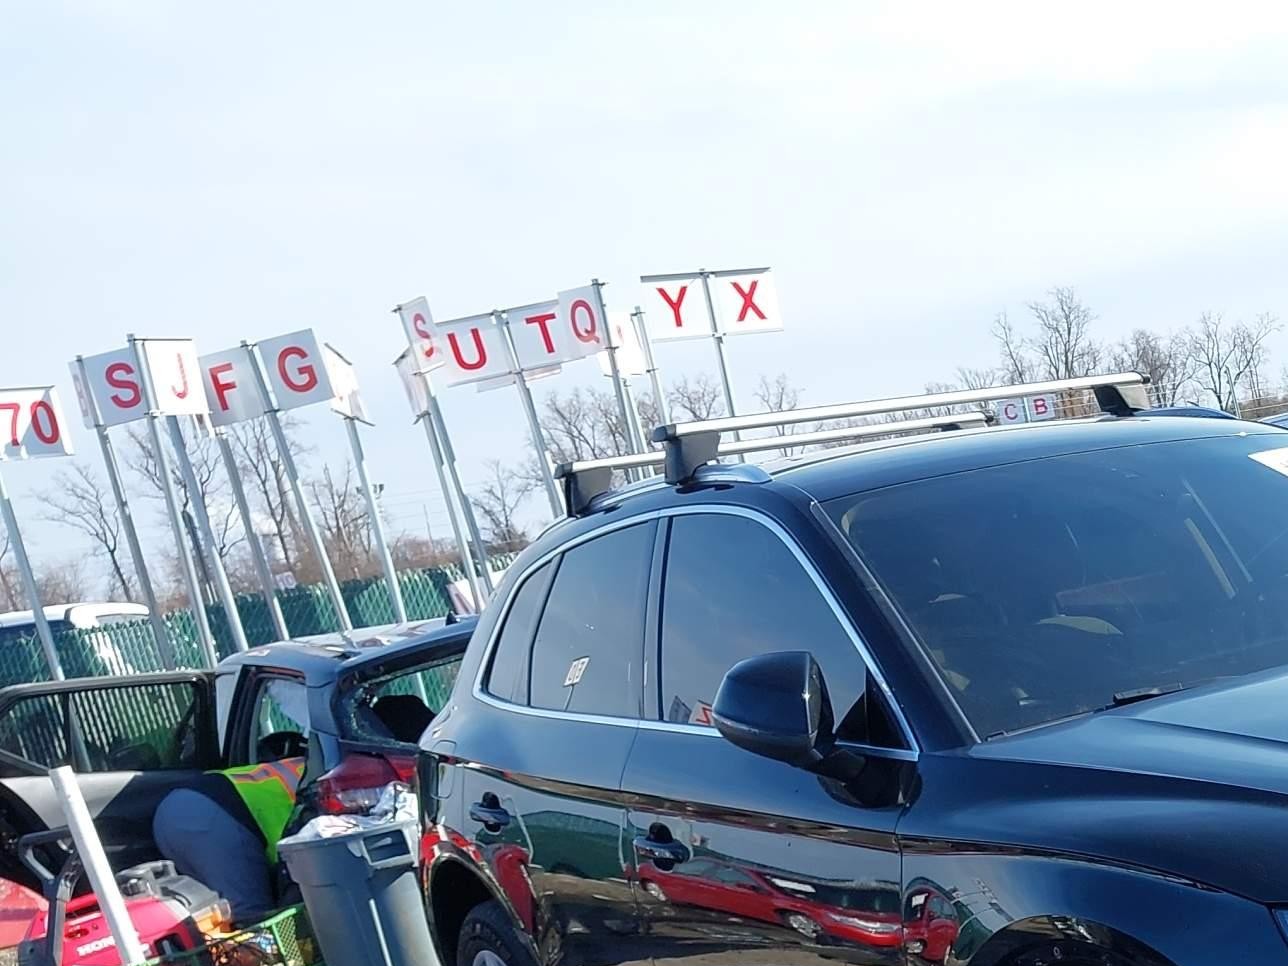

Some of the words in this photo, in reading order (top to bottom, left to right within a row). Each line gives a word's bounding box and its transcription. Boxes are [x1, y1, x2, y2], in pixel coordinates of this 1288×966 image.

[570, 299, 600, 343] Q
[656, 285, 687, 327] Y
[730, 280, 767, 321] X
[447, 327, 487, 370] U
[525, 313, 556, 353] T
[105, 362, 142, 409] S
[208, 362, 237, 411] F
[277, 346, 318, 392] G
[0, 400, 60, 446] 70
[1004, 403, 1018, 420] C
[1033, 398, 1048, 415] B
